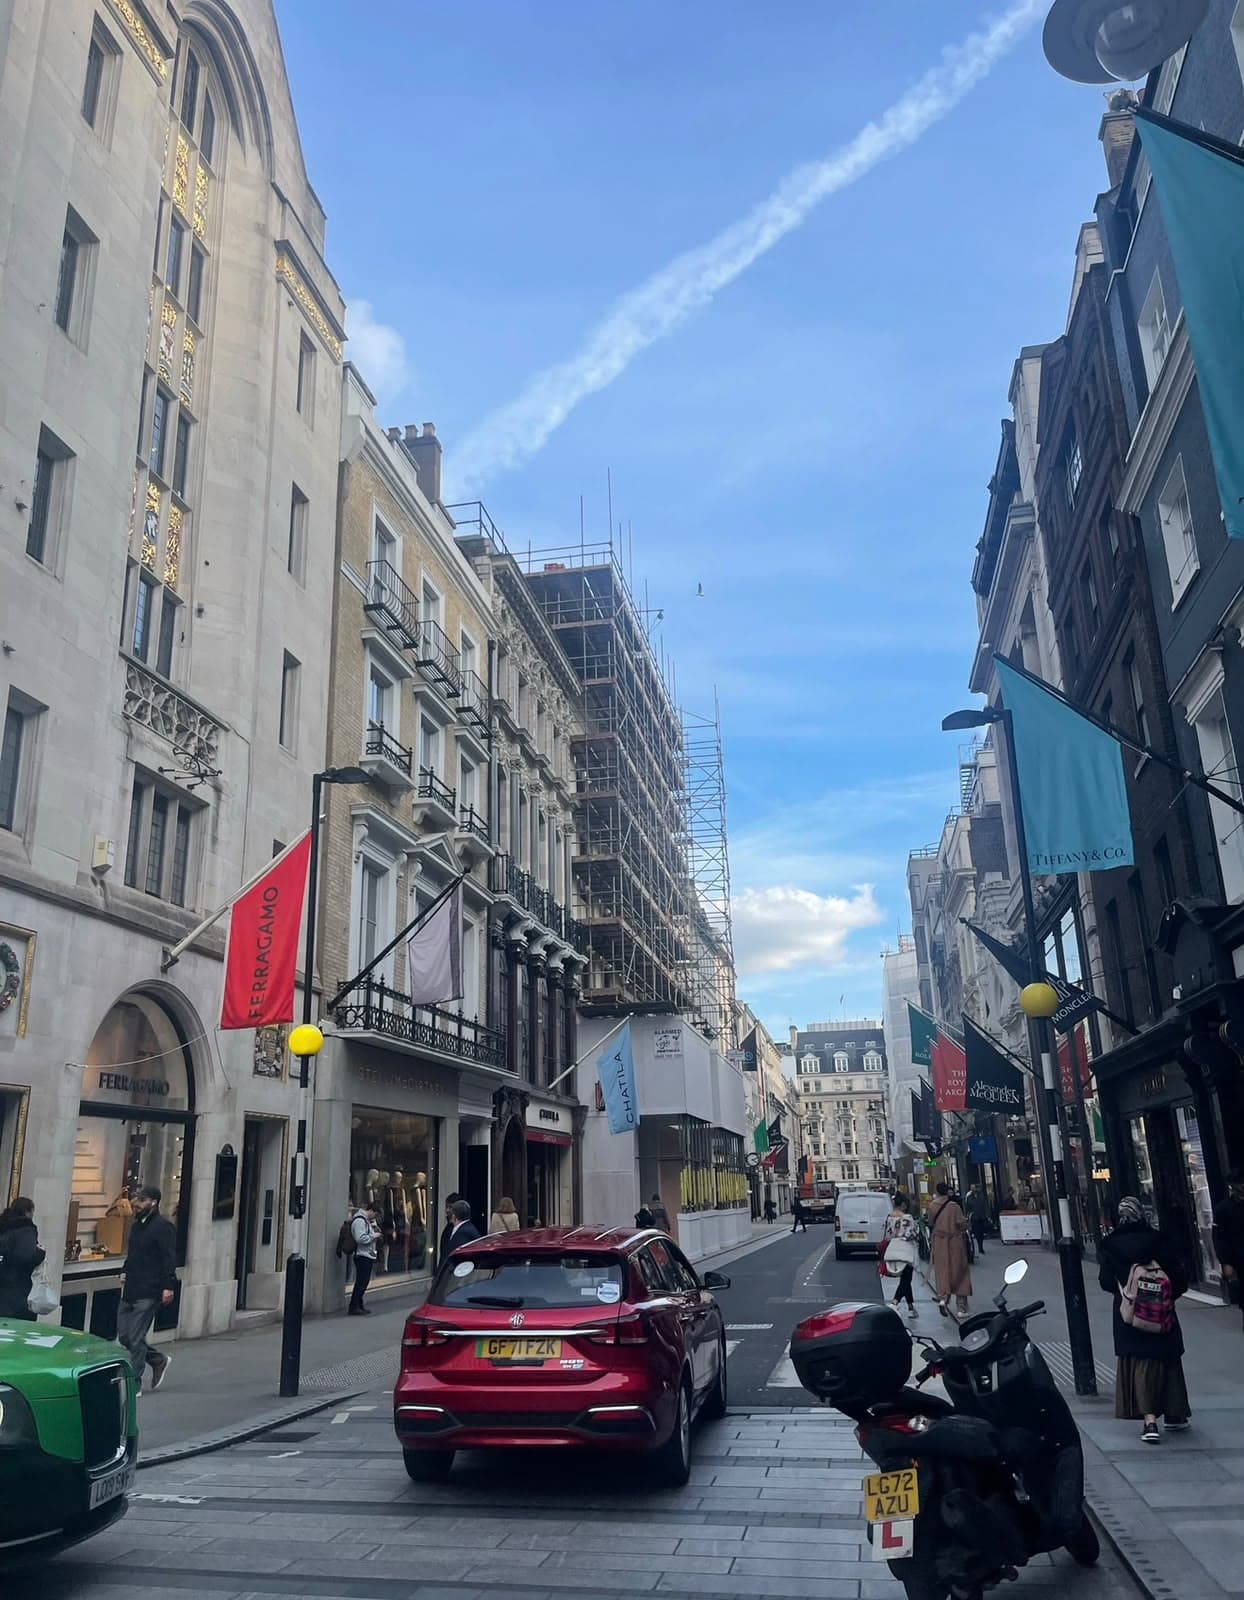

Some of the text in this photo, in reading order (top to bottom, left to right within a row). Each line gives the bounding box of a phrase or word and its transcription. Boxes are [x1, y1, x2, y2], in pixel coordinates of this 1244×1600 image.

[1032, 851, 1091, 866] TIFFANY
[249, 886, 279, 1019] FERRAGAMO
[1051, 991, 1095, 1024] MONCLER
[951, 1070, 966, 1078] TH
[614, 1051, 635, 1124] CHATILA
[972, 1080, 1017, 1096] Alexander
[488, 1338, 557, 1356] GF71 FZK
[867, 1472, 914, 1497] LG72
[874, 1493, 909, 1517] AZU
[882, 1521, 904, 1549] L
